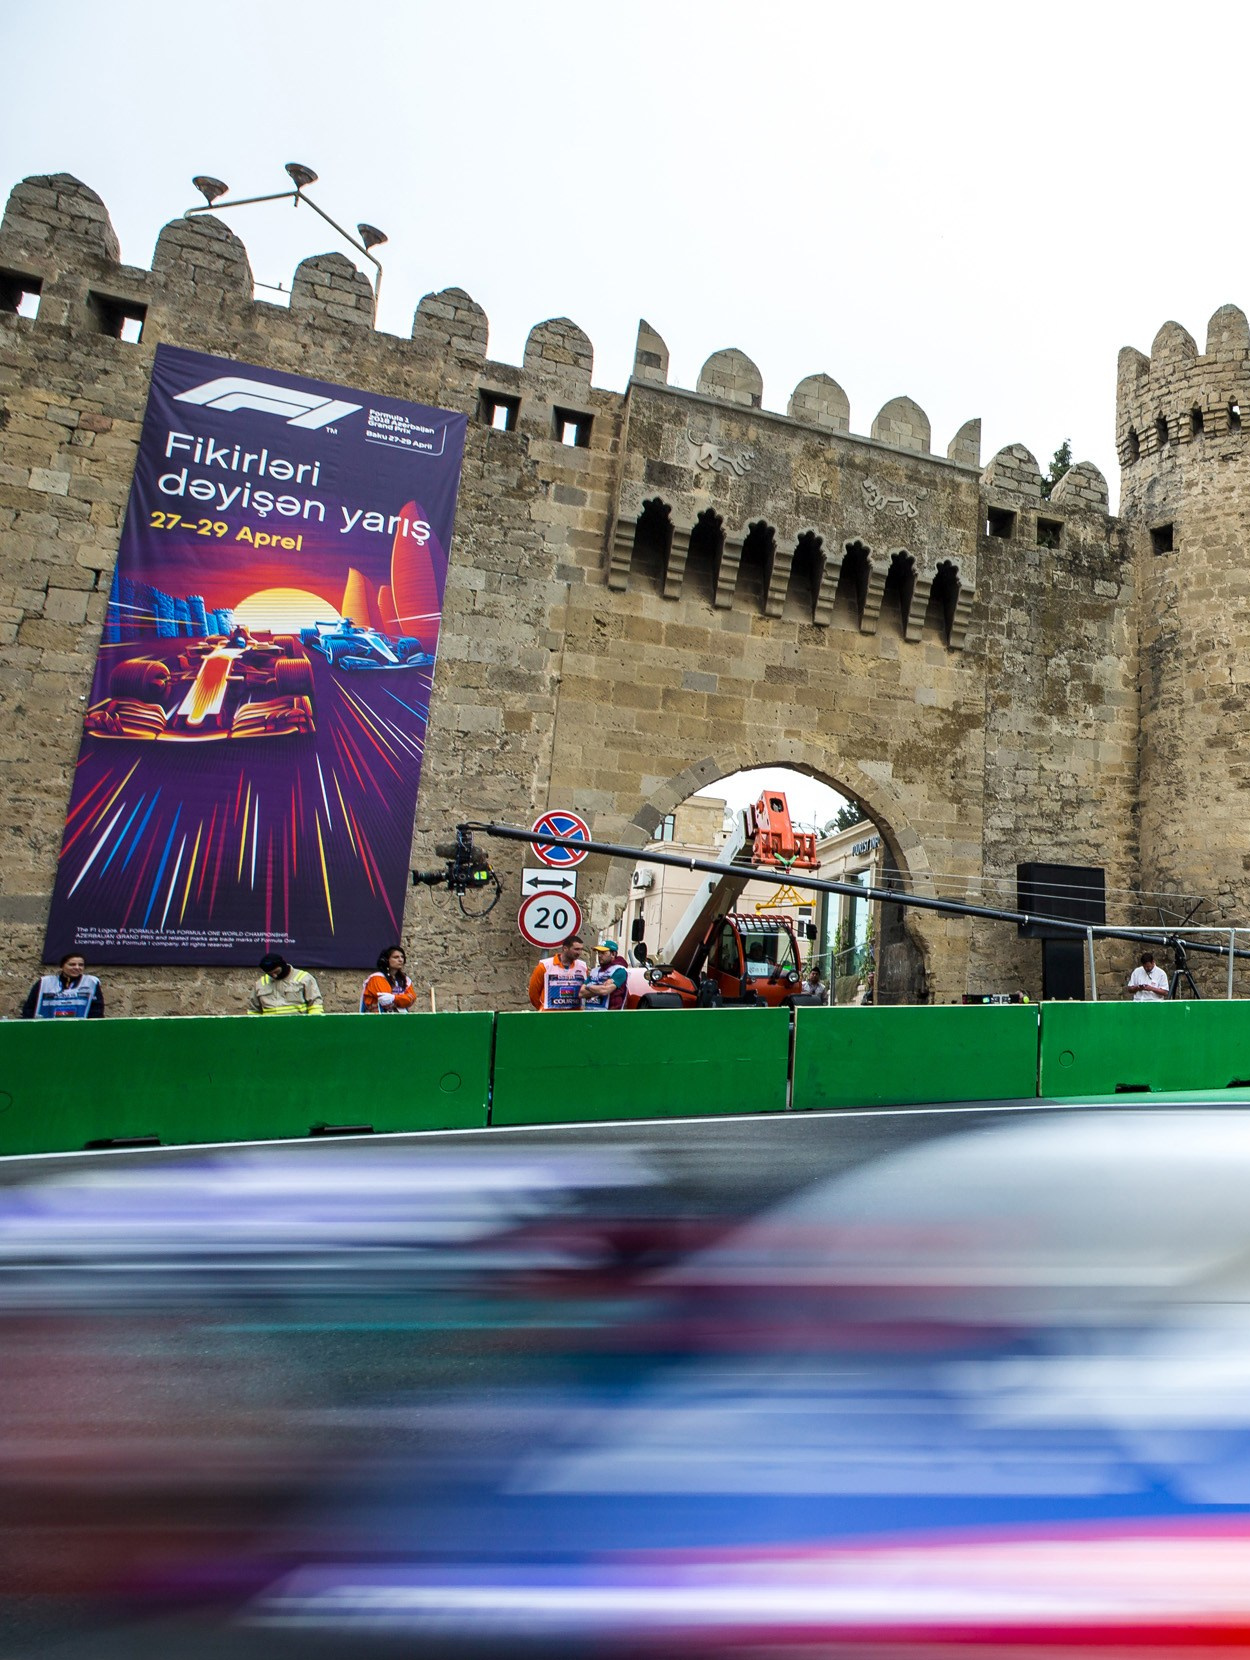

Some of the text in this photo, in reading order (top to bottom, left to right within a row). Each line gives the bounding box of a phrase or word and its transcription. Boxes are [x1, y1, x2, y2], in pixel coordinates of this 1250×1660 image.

[369, 408, 404, 422] Formula
[367, 420, 411, 435] Grand Prix
[391, 419, 435, 434] Azerbaijan
[366, 430, 433, 450] Baku 27-29 April
[165, 431, 321, 487] Fikirləri
[158, 468, 431, 546] dəyişən yarış
[235, 526, 303, 551] Aprel
[534, 907, 569, 930] 20
